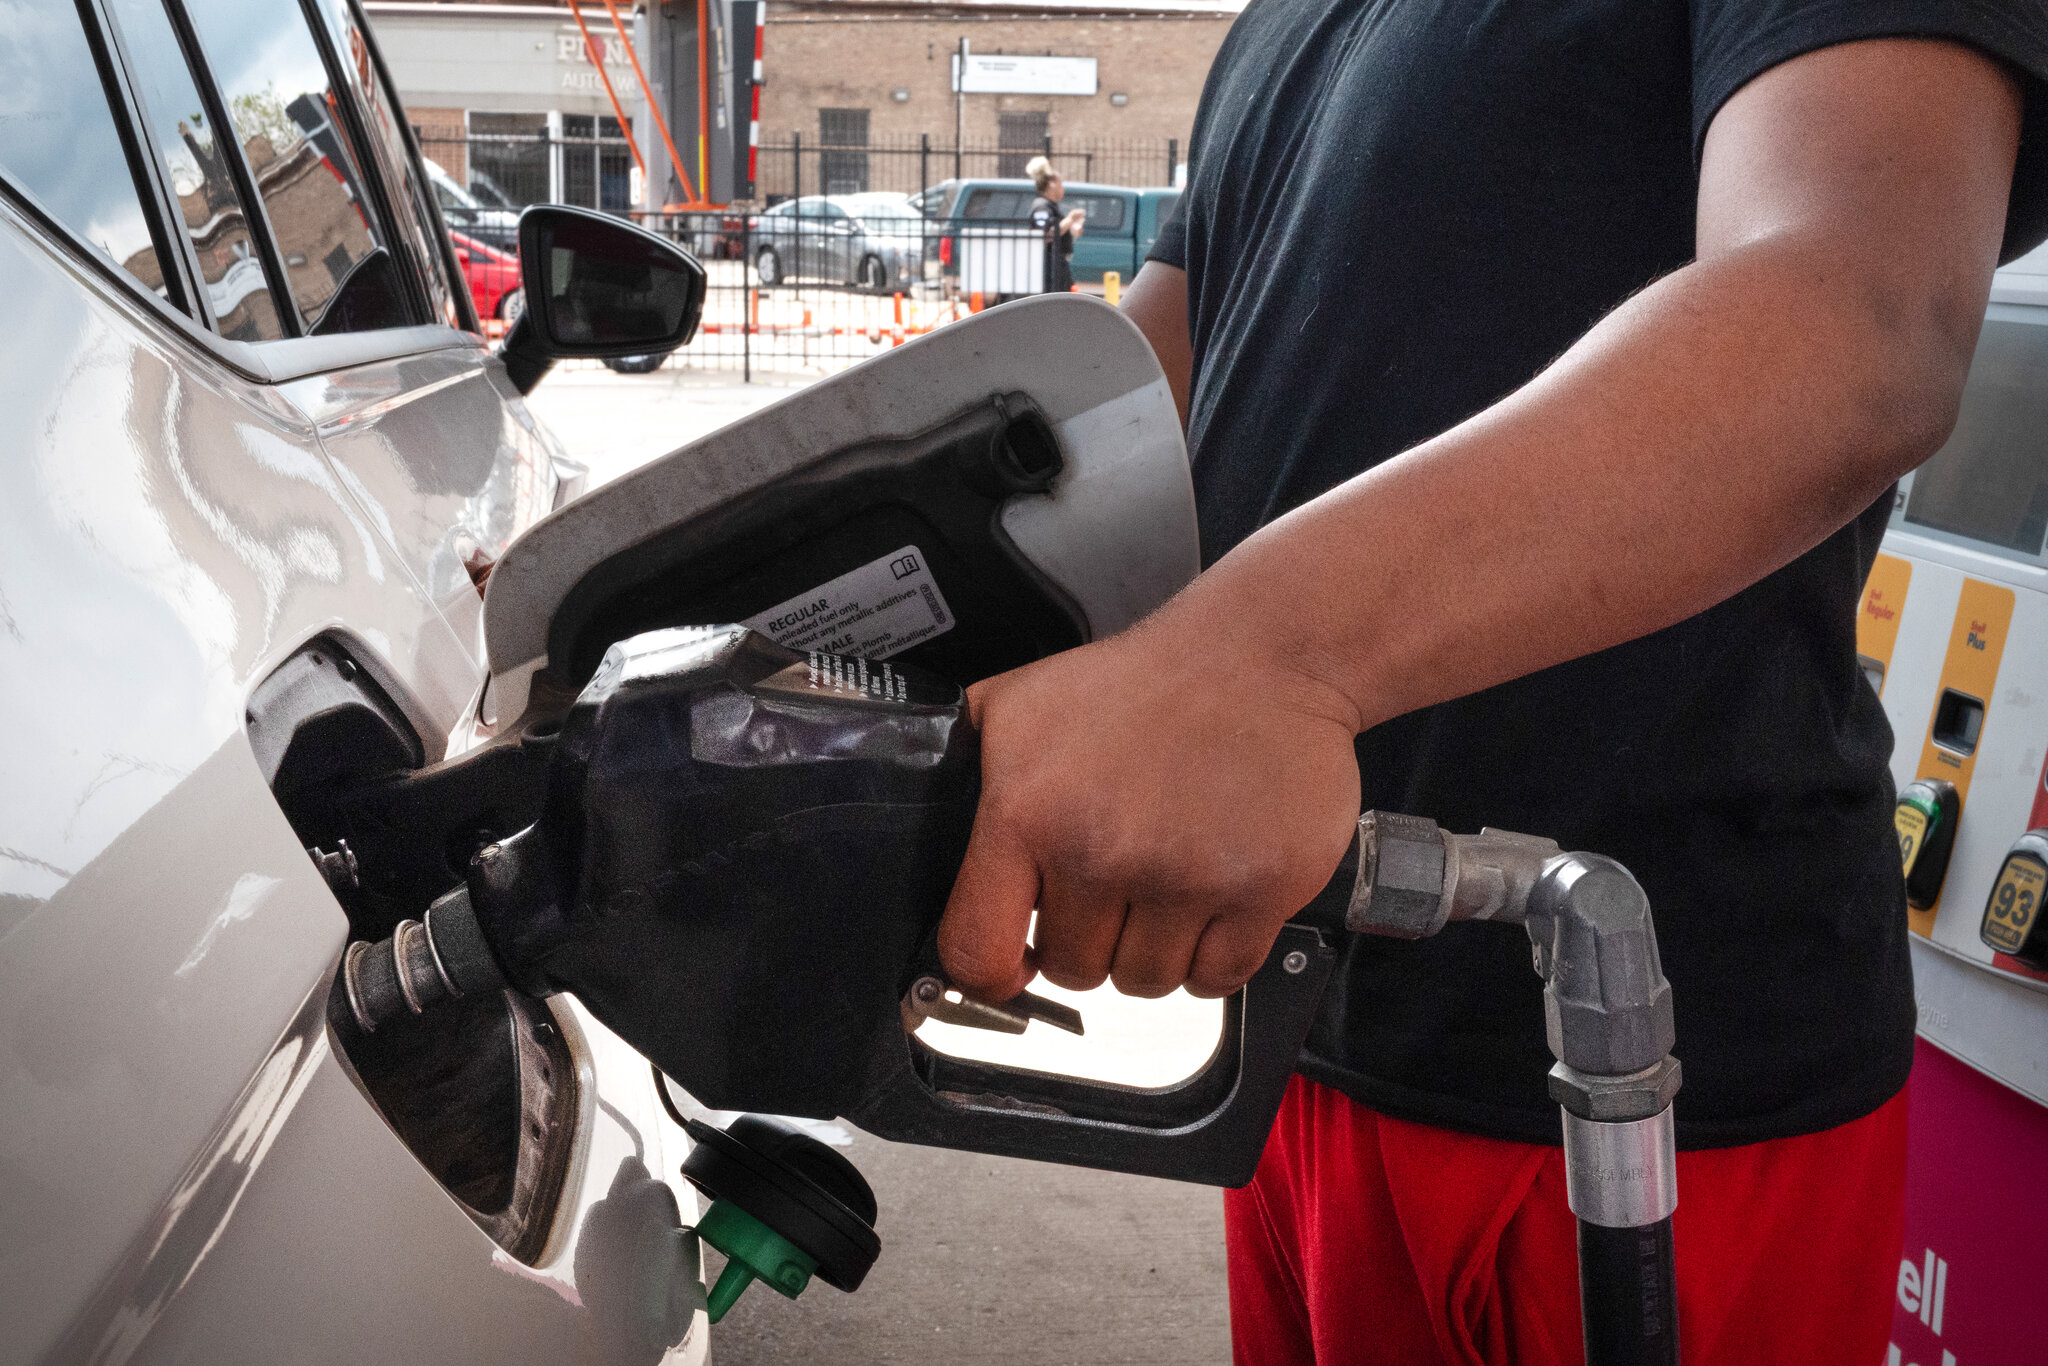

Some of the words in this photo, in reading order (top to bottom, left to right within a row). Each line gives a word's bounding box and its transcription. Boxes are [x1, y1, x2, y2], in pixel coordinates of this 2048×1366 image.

[768, 599, 830, 634] REGULAR
[776, 620, 819, 644] unleaded
[818, 610, 838, 624] fuel
[839, 602, 859, 616] only
[820, 626, 836, 637] any
[838, 607, 875, 628] metallic
[876, 589, 917, 612] additives
[861, 632, 892, 650] Plomb
[1967, 632, 1985, 651] Plus
[1995, 882, 2034, 927] 93
